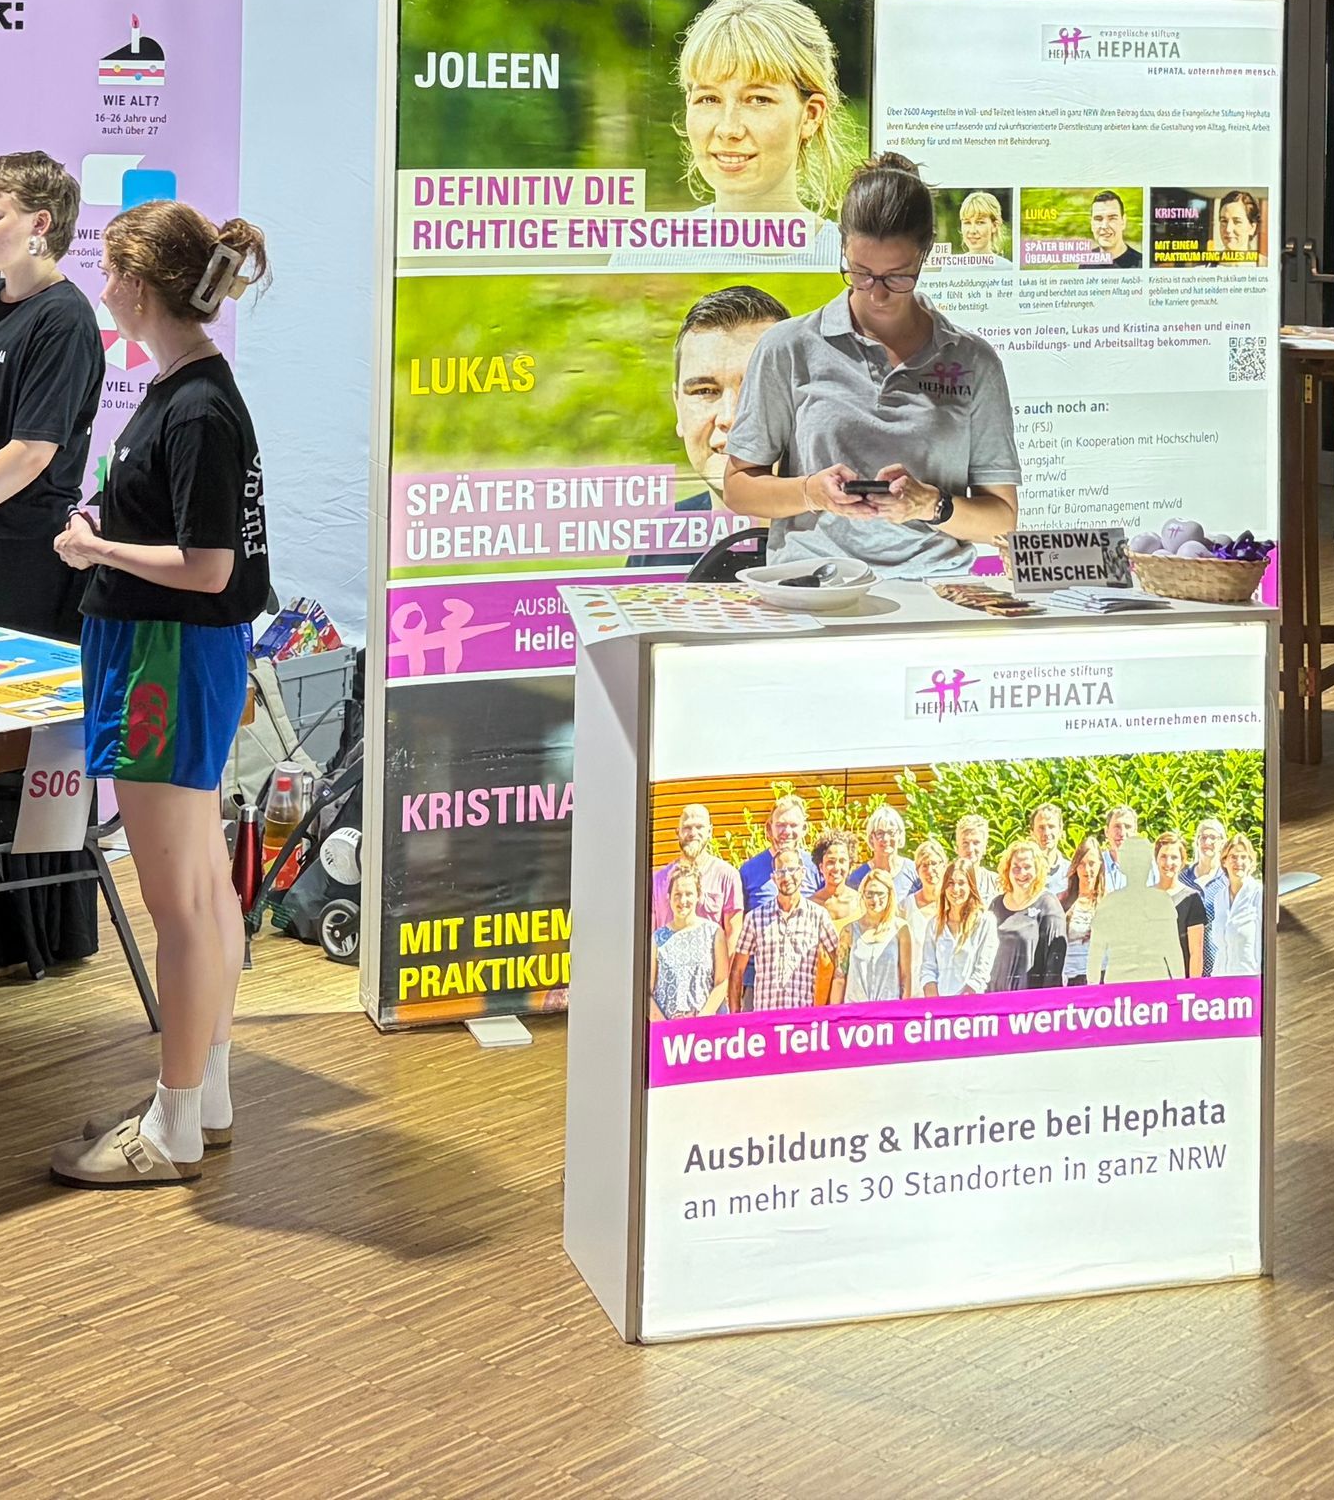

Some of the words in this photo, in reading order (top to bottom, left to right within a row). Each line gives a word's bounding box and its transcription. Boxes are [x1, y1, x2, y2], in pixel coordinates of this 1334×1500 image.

[1098, 41, 1181, 58] HEPHATA
[414, 51, 560, 90] JOLEEN
[104, 95, 126, 106] WIE
[130, 95, 160, 107] ALT?
[123, 114, 147, 124] Jahre
[150, 113, 167, 123] und
[101, 125, 122, 135] auch
[125, 125, 145, 135] über
[148, 125, 158, 135] 27
[413, 175, 575, 207] DEFINITIV
[583, 175, 635, 206] DIE
[1025, 209, 1058, 220] LUKAS
[1154, 208, 1199, 218] KRISTINA
[78, 229, 100, 240] WIE
[412, 218, 559, 250] RICHTIGE
[568, 219, 807, 249] ENTSCHEIDUNG
[935, 244, 949, 254] DIE
[1025, 240, 1057, 251] SPÄTER
[1058, 242, 1074, 251] BIN
[1076, 241, 1091, 251] ICH
[1154, 240, 1171, 250] MIT
[1172, 240, 1199, 250] EINEM
[931, 256, 994, 266] ENTSCHEIDUNG
[1062, 253, 1112, 264] EINSETZBAR
[1221, 251, 1245, 261] ALLES
[977, 326, 1011, 336] Stories
[1014, 328, 1032, 336] von
[1034, 325, 1069, 336] Joleen,
[1072, 324, 1099, 334] Lukas
[1102, 324, 1120, 334] und
[1123, 323, 1160, 333] Kristina
[1163, 322, 1202, 332] ansehen
[1204, 321, 1222, 331] und
[1225, 321, 1251, 331] einen
[1008, 340, 1071, 352] Ausbildungs-
[1073, 339, 1092, 349] und
[1094, 337, 1155, 350] Arbeitsalltag
[1157, 337, 1212, 347] bekommen.
[410, 353, 536, 395] LUKAS
[105, 381, 134, 393] VIEL
[1024, 402, 1053, 414] auch
[1057, 401, 1087, 413] noch
[1090, 401, 1109, 413] an:
[1031, 421, 1053, 433] (FSJ)
[1028, 438, 1058, 449] Arbeit
[1060, 437, 1073, 450] (in
[1075, 435, 1135, 448] Kooperation
[1137, 434, 1153, 445] mit
[1156, 431, 1219, 445] Hochschulen)
[1035, 470, 1067, 482] m/w/d
[406, 474, 535, 516] SPÄTER
[545, 476, 603, 509] BIN
[613, 475, 668, 508] ICH
[1078, 485, 1109, 497] m/w/d
[1047, 503, 1061, 515] für
[1064, 500, 1150, 515] Büromanagement
[1152, 498, 1183, 509] m/w/d
[405, 521, 551, 561] ÜBERALL
[559, 516, 752, 554] EINSETZBAR
[1013, 532, 1111, 550] IRGENDWAS
[1015, 551, 1045, 566] MIT
[1017, 565, 1109, 583] MENSCHEN
[993, 667, 1066, 681] evangelische
[1070, 666, 1114, 678] stiftung
[990, 682, 1114, 709] HEPHATA
[1065, 717, 1122, 730] HEPHATA.
[1125, 713, 1208, 727] unternehmen
[1211, 711, 1262, 724] mensch.
[28, 769, 81, 799] S06
[402, 782, 575, 832] KRISTINA
[400, 916, 464, 956] MIT
[662, 1027, 766, 1066] Werde
[774, 1020, 830, 1055] Teil
[838, 1022, 894, 1049] von
[904, 1011, 1000, 1045] einem
[1008, 997, 1169, 1035] wertvollen
[1177, 992, 1254, 1022] Team
[683, 1129, 869, 1174] Ausbildung
[878, 1125, 903, 1152] &
[913, 1115, 1036, 1151] Karriere
[1046, 1106, 1092, 1137] bei
[1101, 1098, 1227, 1141] Hephata
[683, 1198, 717, 1221] an
[729, 1183, 800, 1216] mehr
[809, 1178, 849, 1206] als
[859, 1175, 894, 1203] 30
[904, 1162, 1053, 1198] Standorten
[1063, 1156, 1087, 1181] in
[1097, 1155, 1159, 1185] ganz
[1168, 1144, 1227, 1172] NRW
